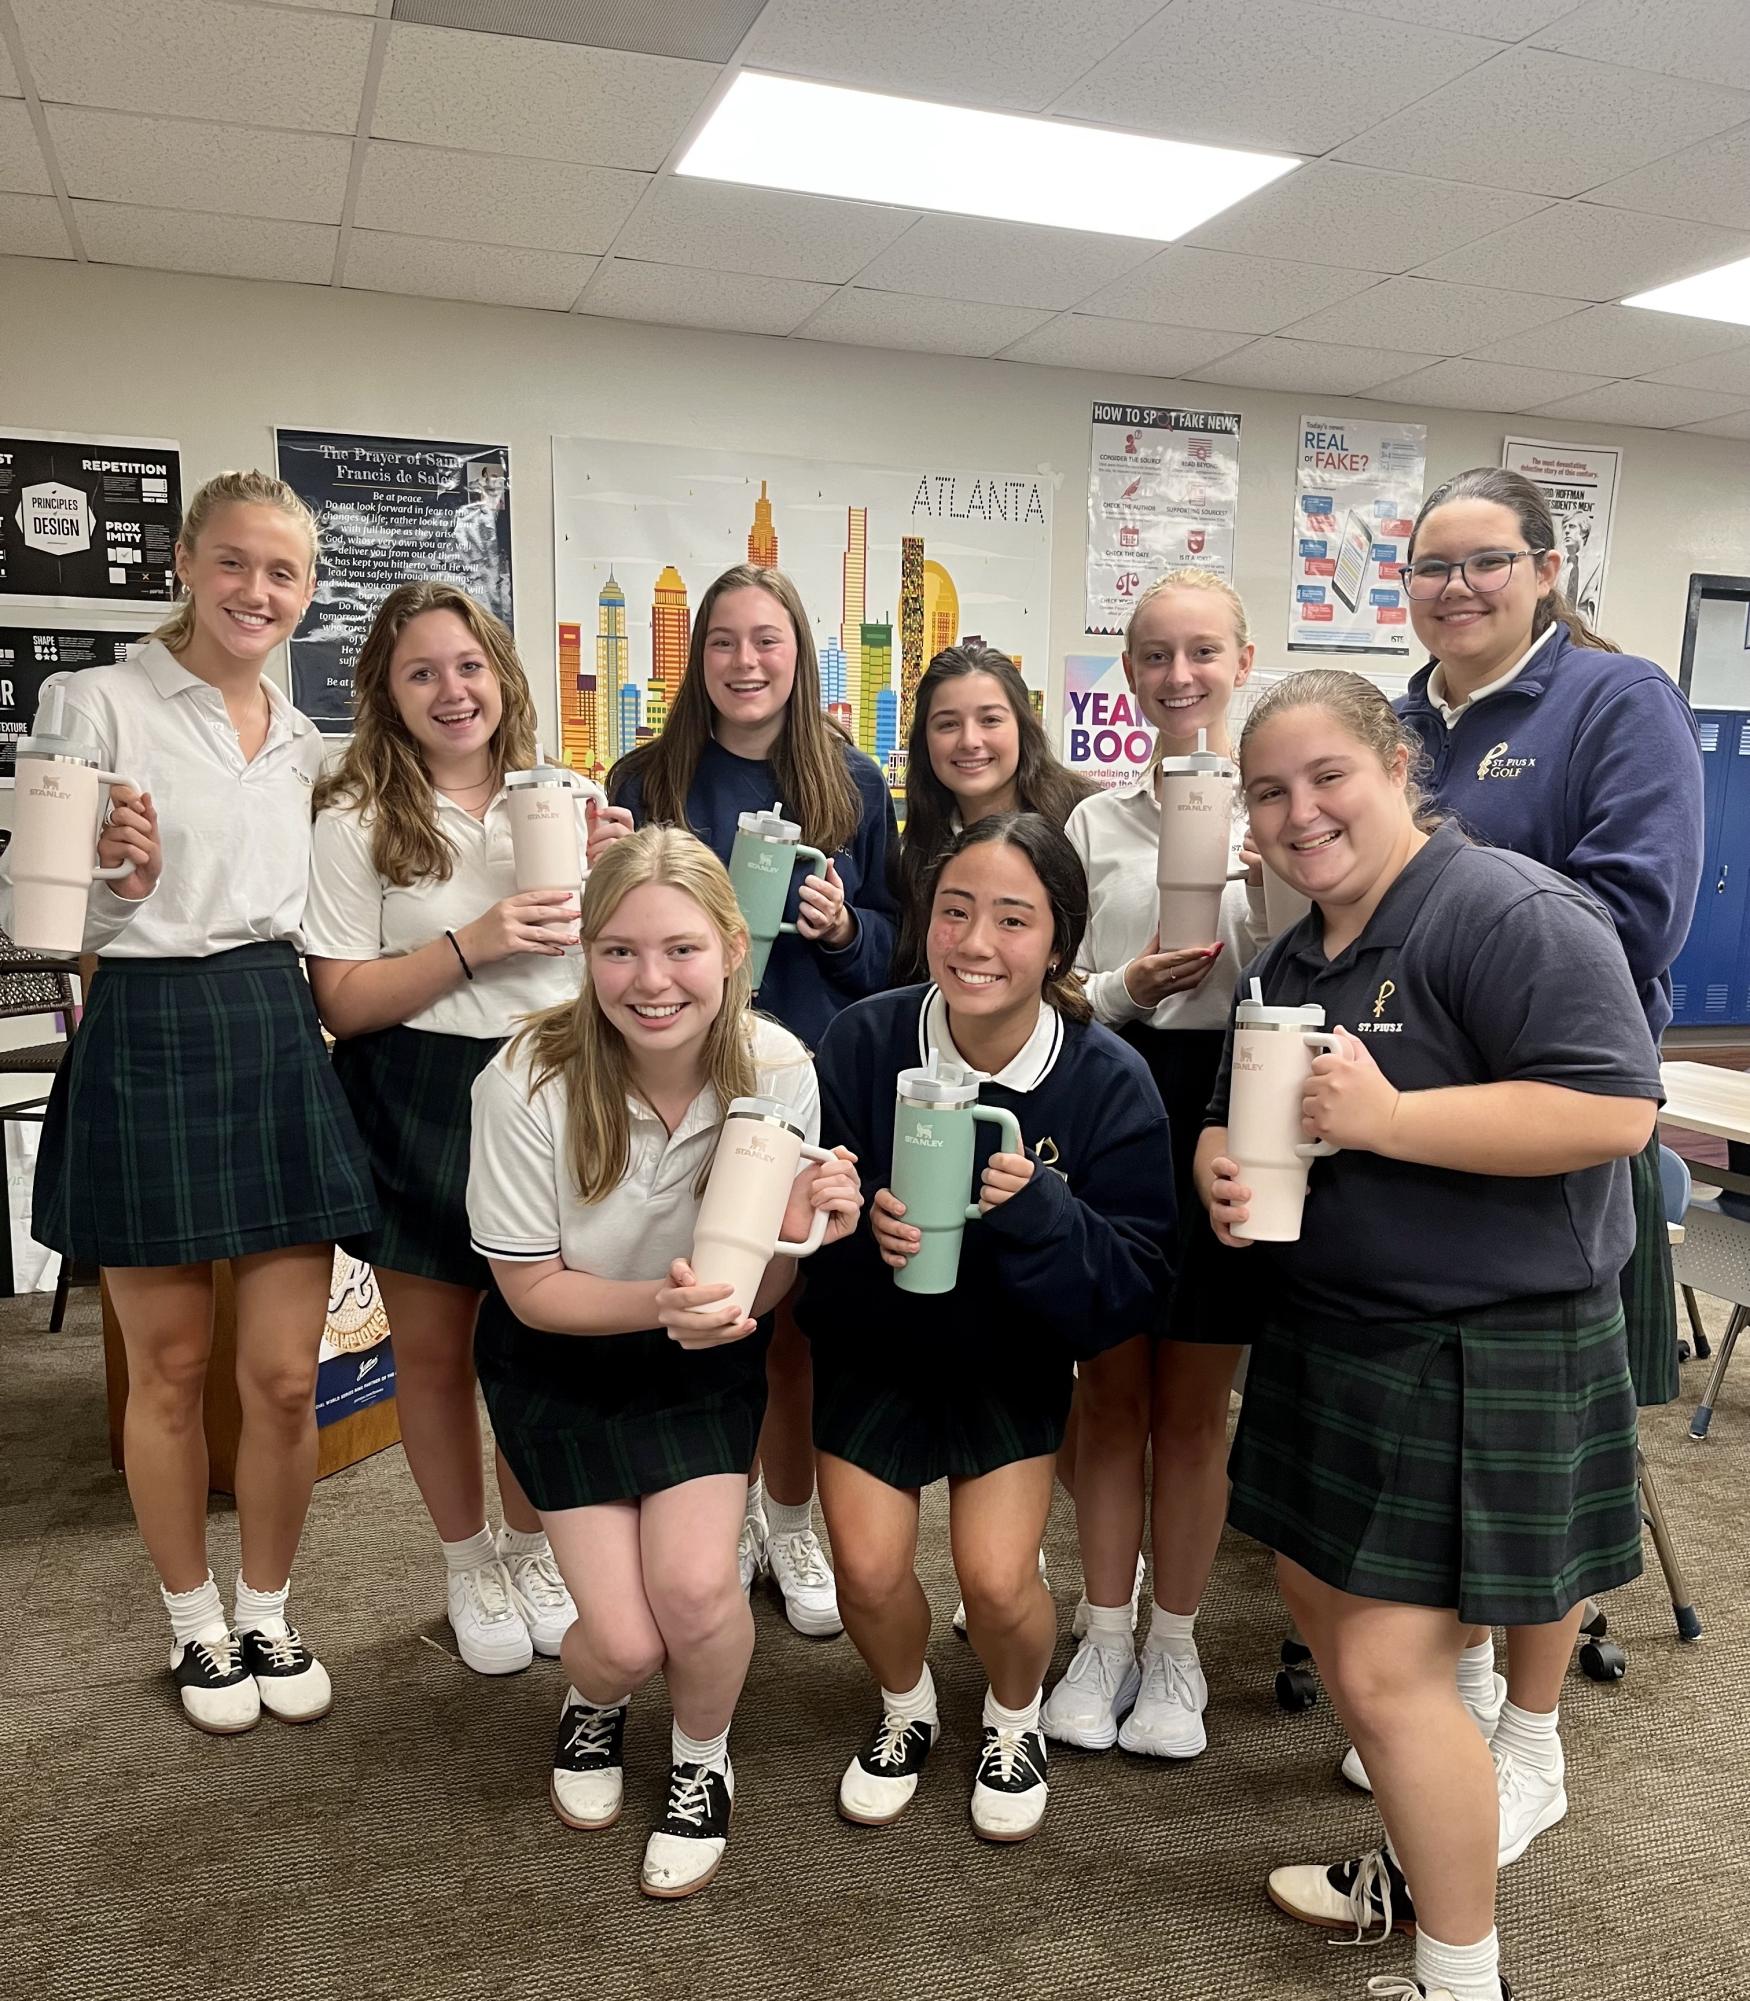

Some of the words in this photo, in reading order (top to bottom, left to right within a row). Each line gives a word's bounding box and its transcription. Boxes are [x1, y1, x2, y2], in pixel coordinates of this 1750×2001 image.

[1094, 405, 1123, 422] HOW
[1126, 408, 1140, 424] TO
[1179, 412, 1204, 429] FAKE
[1208, 416, 1239, 432] NEWS
[1306, 421, 1328, 431] Today's
[1328, 424, 1345, 432] news:
[1304, 431, 1349, 453] REAL
[320, 444, 348, 460] The
[354, 447, 401, 466] Prayer
[406, 451, 422, 466] of
[426, 452, 464, 469] Saint
[1100, 454, 1127, 463] CONSIDER
[1129, 456, 1138, 464] THE
[1304, 455, 1314, 463] or
[1315, 451, 1369, 473] FAKE?
[82, 459, 167, 476] REPETITION
[1532, 457, 1541, 465] The
[1542, 459, 1555, 467] most
[1556, 461, 1587, 471] devastating
[336, 465, 391, 483] Francis
[396, 470, 412, 484] de
[1520, 465, 1543, 473] detective
[1543, 467, 1558, 476] story
[1564, 468, 1575, 476] this
[373, 491, 384, 501] Be
[386, 492, 396, 502] at
[397, 494, 424, 506] peace.
[912, 475, 1044, 524] ATLANTA
[1543, 488, 1585, 500] RD/HOFFMAN
[32, 497, 78, 511] PRINCIPLES
[325, 500, 336, 510] Do
[338, 501, 354, 511] not
[356, 502, 376, 512] look
[377, 503, 413, 515] forward
[415, 505, 423, 514] in
[425, 505, 443, 518] fear
[444, 508, 453, 516] to
[1547, 499, 1579, 511] ESIDENT'S
[322, 512, 359, 523] changes
[361, 514, 371, 525] of
[372, 514, 388, 527] life;
[390, 516, 418, 526] rather
[419, 517, 438, 527] look
[439, 519, 448, 527] to
[33, 517, 80, 537] DESIGN
[105, 521, 141, 533] PROX
[341, 524, 361, 535] with
[363, 525, 378, 537] full
[380, 526, 401, 538] hope
[403, 529, 413, 537] as
[415, 528, 434, 540] they
[106, 532, 142, 543] IMITY
[325, 534, 346, 546] God,
[348, 537, 376, 547] whose
[378, 540, 396, 551] very
[398, 540, 417, 549] own
[419, 541, 435, 551] you
[437, 542, 453, 552] are,
[338, 546, 369, 557] deliver
[370, 549, 387, 560] you
[388, 549, 410, 561] from
[411, 551, 426, 560] out
[427, 550, 438, 562] of
[321, 557, 333, 566] He
[334, 557, 350, 566] has
[352, 559, 371, 570] kept
[373, 561, 389, 572] you
[391, 560, 428, 571] hitherto,
[430, 562, 447, 571] and
[449, 563, 461, 572] He
[462, 564, 479, 573] will
[328, 568, 347, 577] lead
[348, 571, 365, 581] you
[367, 570, 393, 582] safely
[394, 572, 426, 583] through
[430, 572, 442, 582] all
[317, 579, 335, 588] and
[336, 580, 360, 589] when
[363, 583, 379, 592] you
[467, 586, 484, 595] will
[358, 592, 379, 604] bury
[339, 602, 351, 611] Do
[353, 603, 368, 611] not
[369, 603, 382, 613] fea
[319, 612, 366, 623] tomorrow,
[367, 613, 377, 622] th
[322, 623, 342, 632] who
[344, 625, 367, 633] cares
[33, 636, 55, 646] SHAPE
[349, 634, 358, 645] of
[341, 645, 353, 654] He
[326, 677, 338, 687] Be
[339, 679, 349, 687] at
[1070, 729, 1153, 764] BOO
[1492, 759, 1504, 767] ST.
[1506, 758, 1527, 767] PIUS
[1528, 758, 1536, 767] X
[1080, 768, 1129, 780] mortalizing
[1490, 766, 1522, 778] GOLF
[30, 788, 72, 800] STANLEY
[1177, 804, 1212, 812] STANLEY
[527, 813, 561, 821] STANLEY
[747, 861, 779, 873] STANLEY
[1358, 1022, 1372, 1033] ST.
[1373, 1022, 1396, 1033] PIUS
[1395, 1023, 1403, 1032] X
[904, 1135, 944, 1148] STANLEY
[735, 1147, 775, 1164] STANLEY
[325, 1308, 389, 1349] HAMPIONS
[326, 1396, 341, 1406] WORLD
